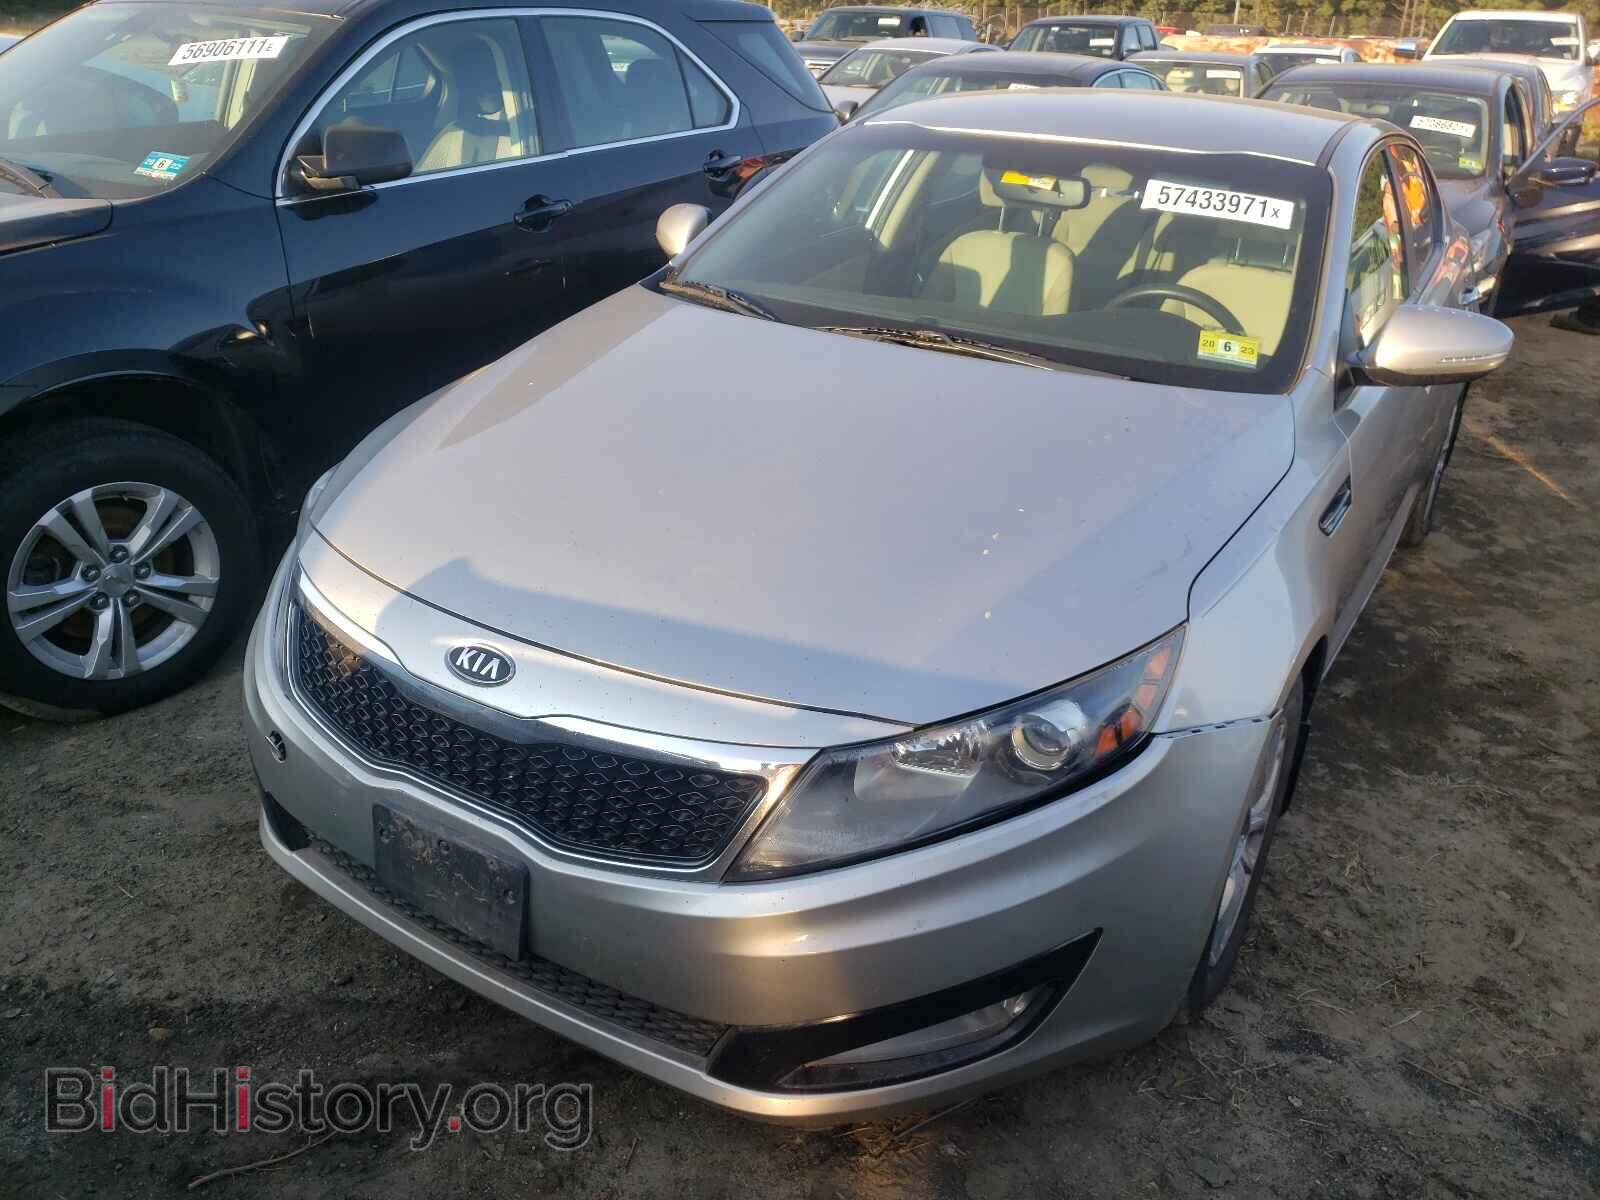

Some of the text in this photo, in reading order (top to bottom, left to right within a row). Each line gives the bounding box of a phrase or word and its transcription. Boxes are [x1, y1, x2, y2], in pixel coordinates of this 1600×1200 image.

[1223, 341, 1232, 352] 6
[1240, 346, 1255, 355] 23
[455, 647, 500, 680] KIA
